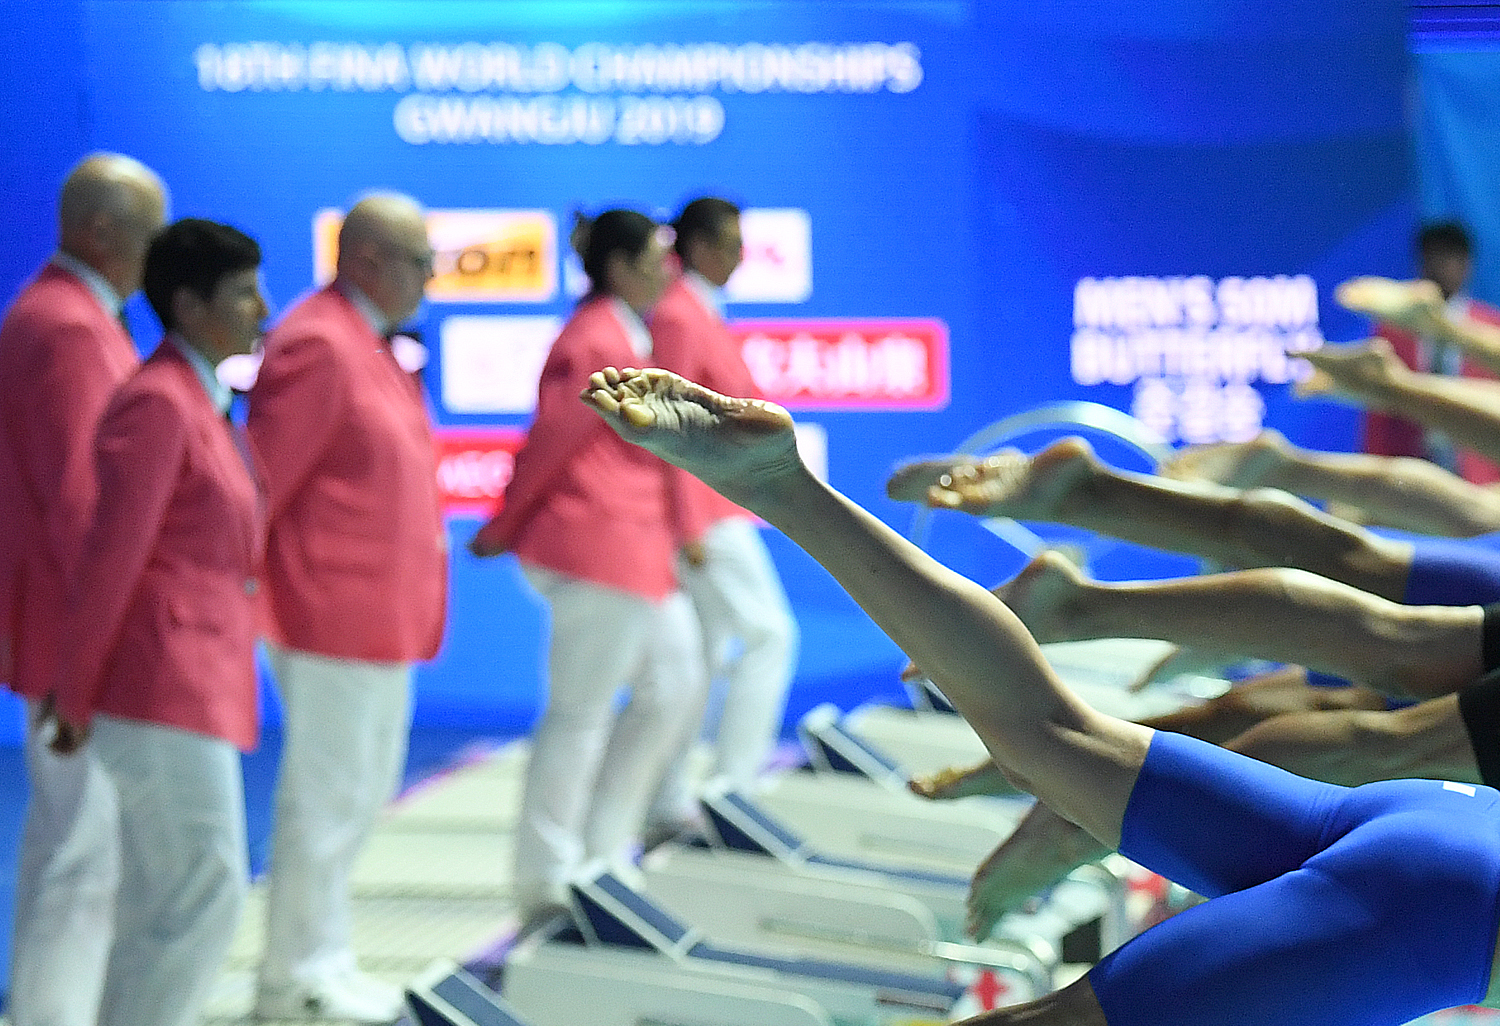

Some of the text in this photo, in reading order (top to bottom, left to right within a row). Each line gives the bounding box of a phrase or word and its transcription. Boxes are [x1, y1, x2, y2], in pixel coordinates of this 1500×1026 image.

[412, 42, 569, 93] WORLD
[571, 42, 923, 93] CHAMPIONSHIPS
[395, 94, 724, 144] GWANGJU 2019
